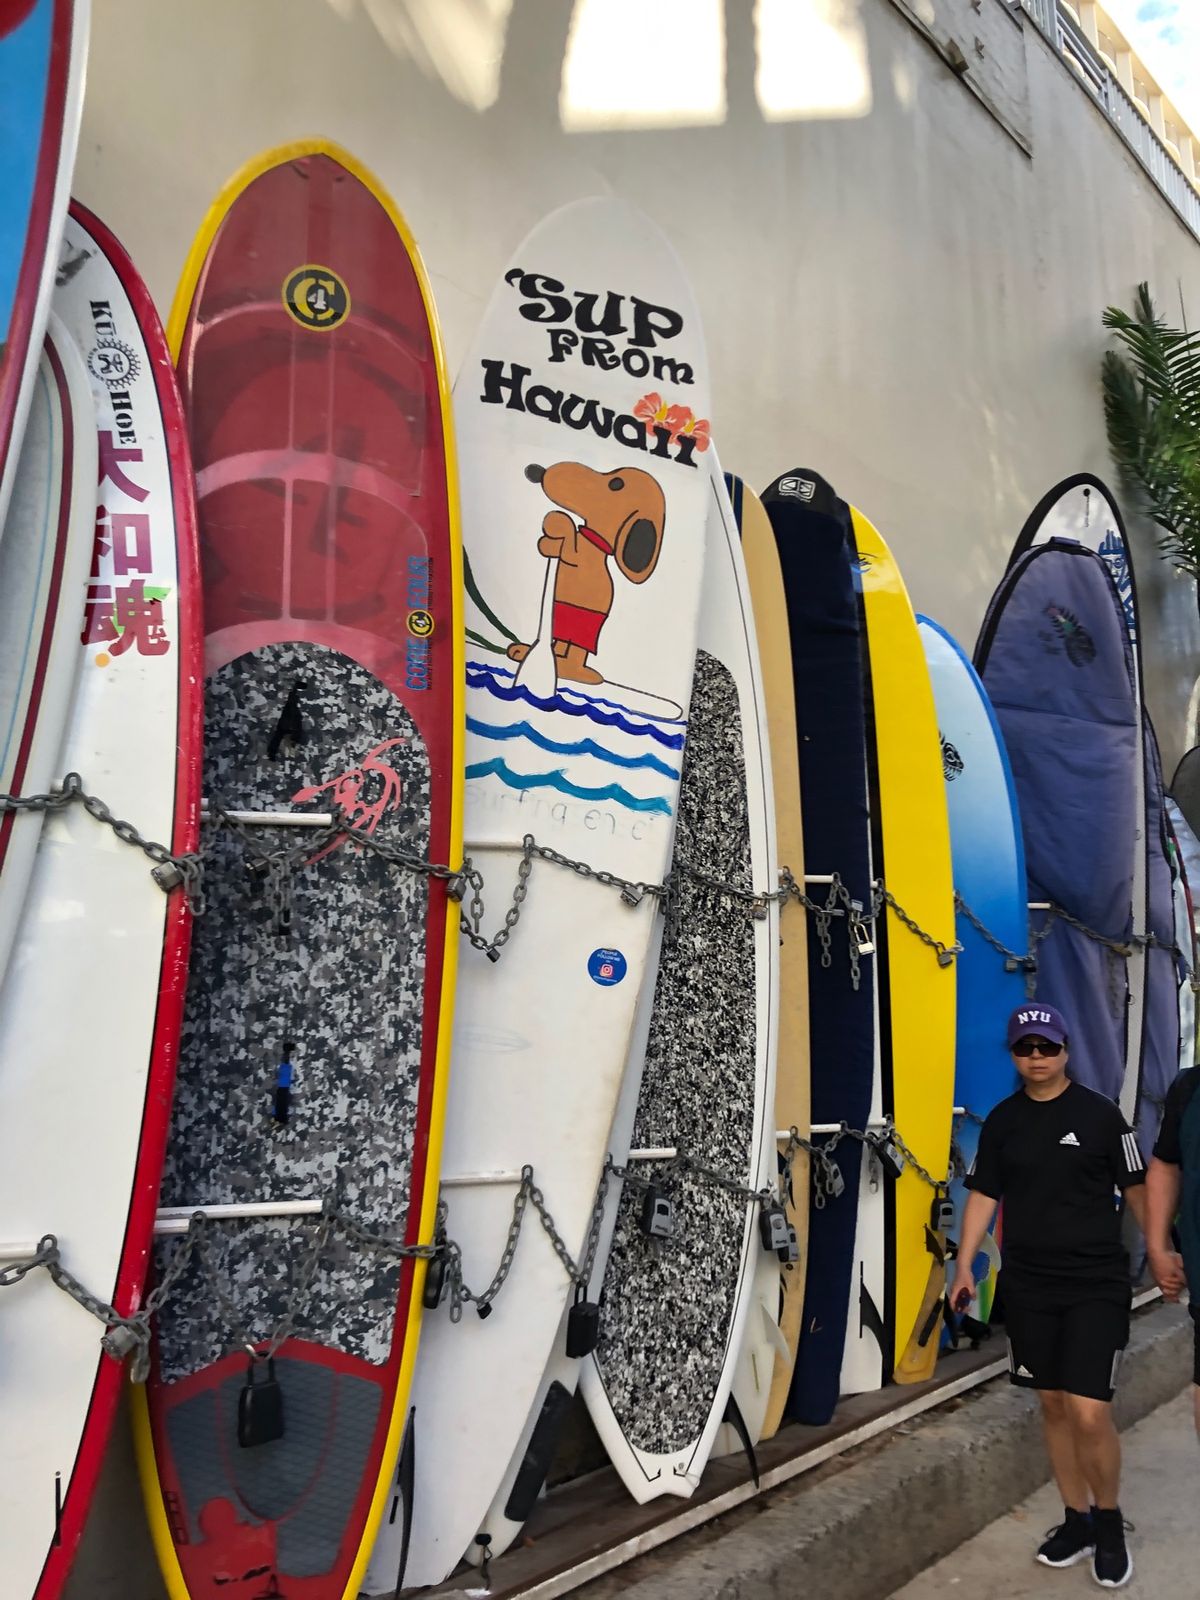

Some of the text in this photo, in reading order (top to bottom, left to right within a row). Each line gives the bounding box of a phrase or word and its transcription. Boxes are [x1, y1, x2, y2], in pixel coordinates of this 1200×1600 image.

[109, 390, 137, 445] HOE
[406, 637, 429, 691] CORE
[1017, 1010, 1052, 1025] NYU
